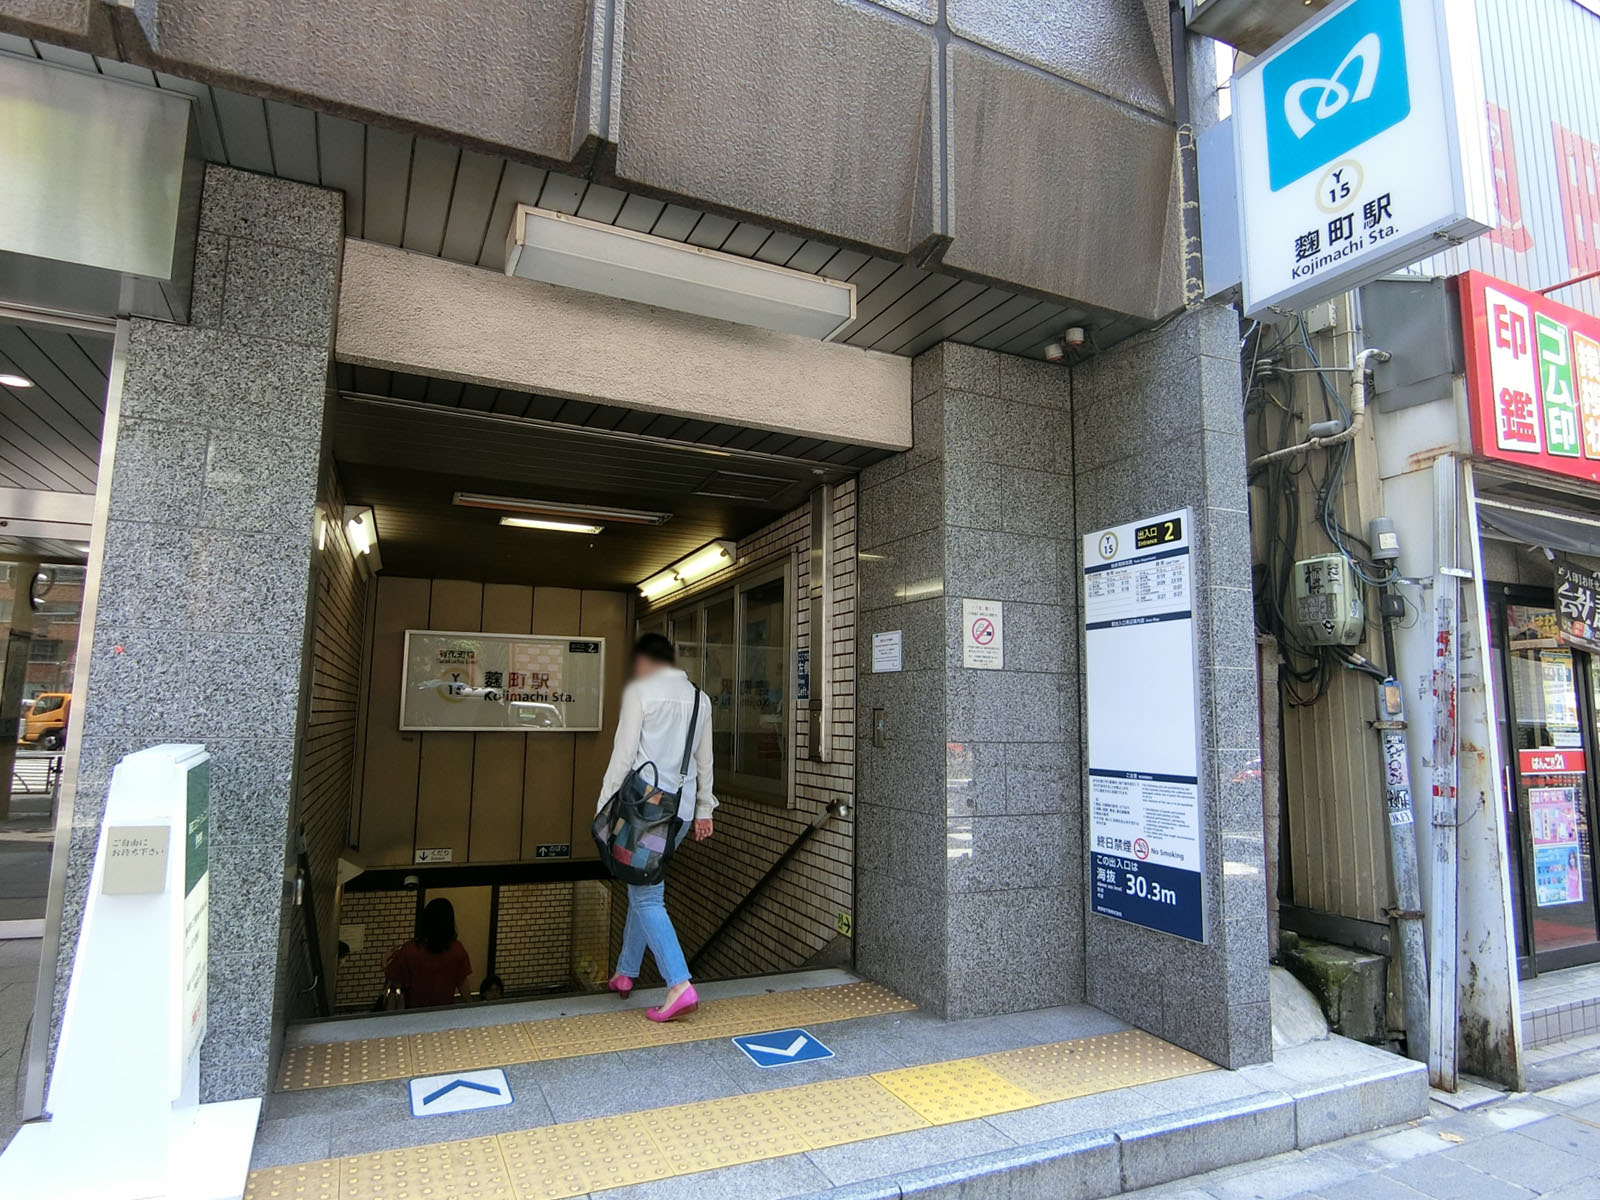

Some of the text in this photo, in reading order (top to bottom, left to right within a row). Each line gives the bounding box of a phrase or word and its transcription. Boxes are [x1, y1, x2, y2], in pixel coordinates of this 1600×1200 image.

[1333, 169, 1344, 184] Y
[1329, 182, 1351, 204] 15
[1291, 224, 1400, 280] Kojimachi Sta.
[1493, 303, 1537, 444] 印鑑
[1539, 322, 1577, 450] ゴム印
[1137, 521, 1175, 541] 出入口 2
[1105, 536, 1111, 544] Y
[1103, 544, 1114, 555] 15
[588, 643, 597, 653] 2
[451, 673, 460, 683] Y
[552, 691, 576, 703] Sta.
[113, 838, 149, 847] ご自由に
[1096, 835, 1132, 853] 終日禁煙
[111, 847, 166, 857] お持ち下さい
[1150, 847, 1185, 862] No Smoking
[1096, 855, 1139, 872] この出入口は
[1096, 867, 1117, 885] 海抜
[1125, 873, 1177, 906] 30.3m
